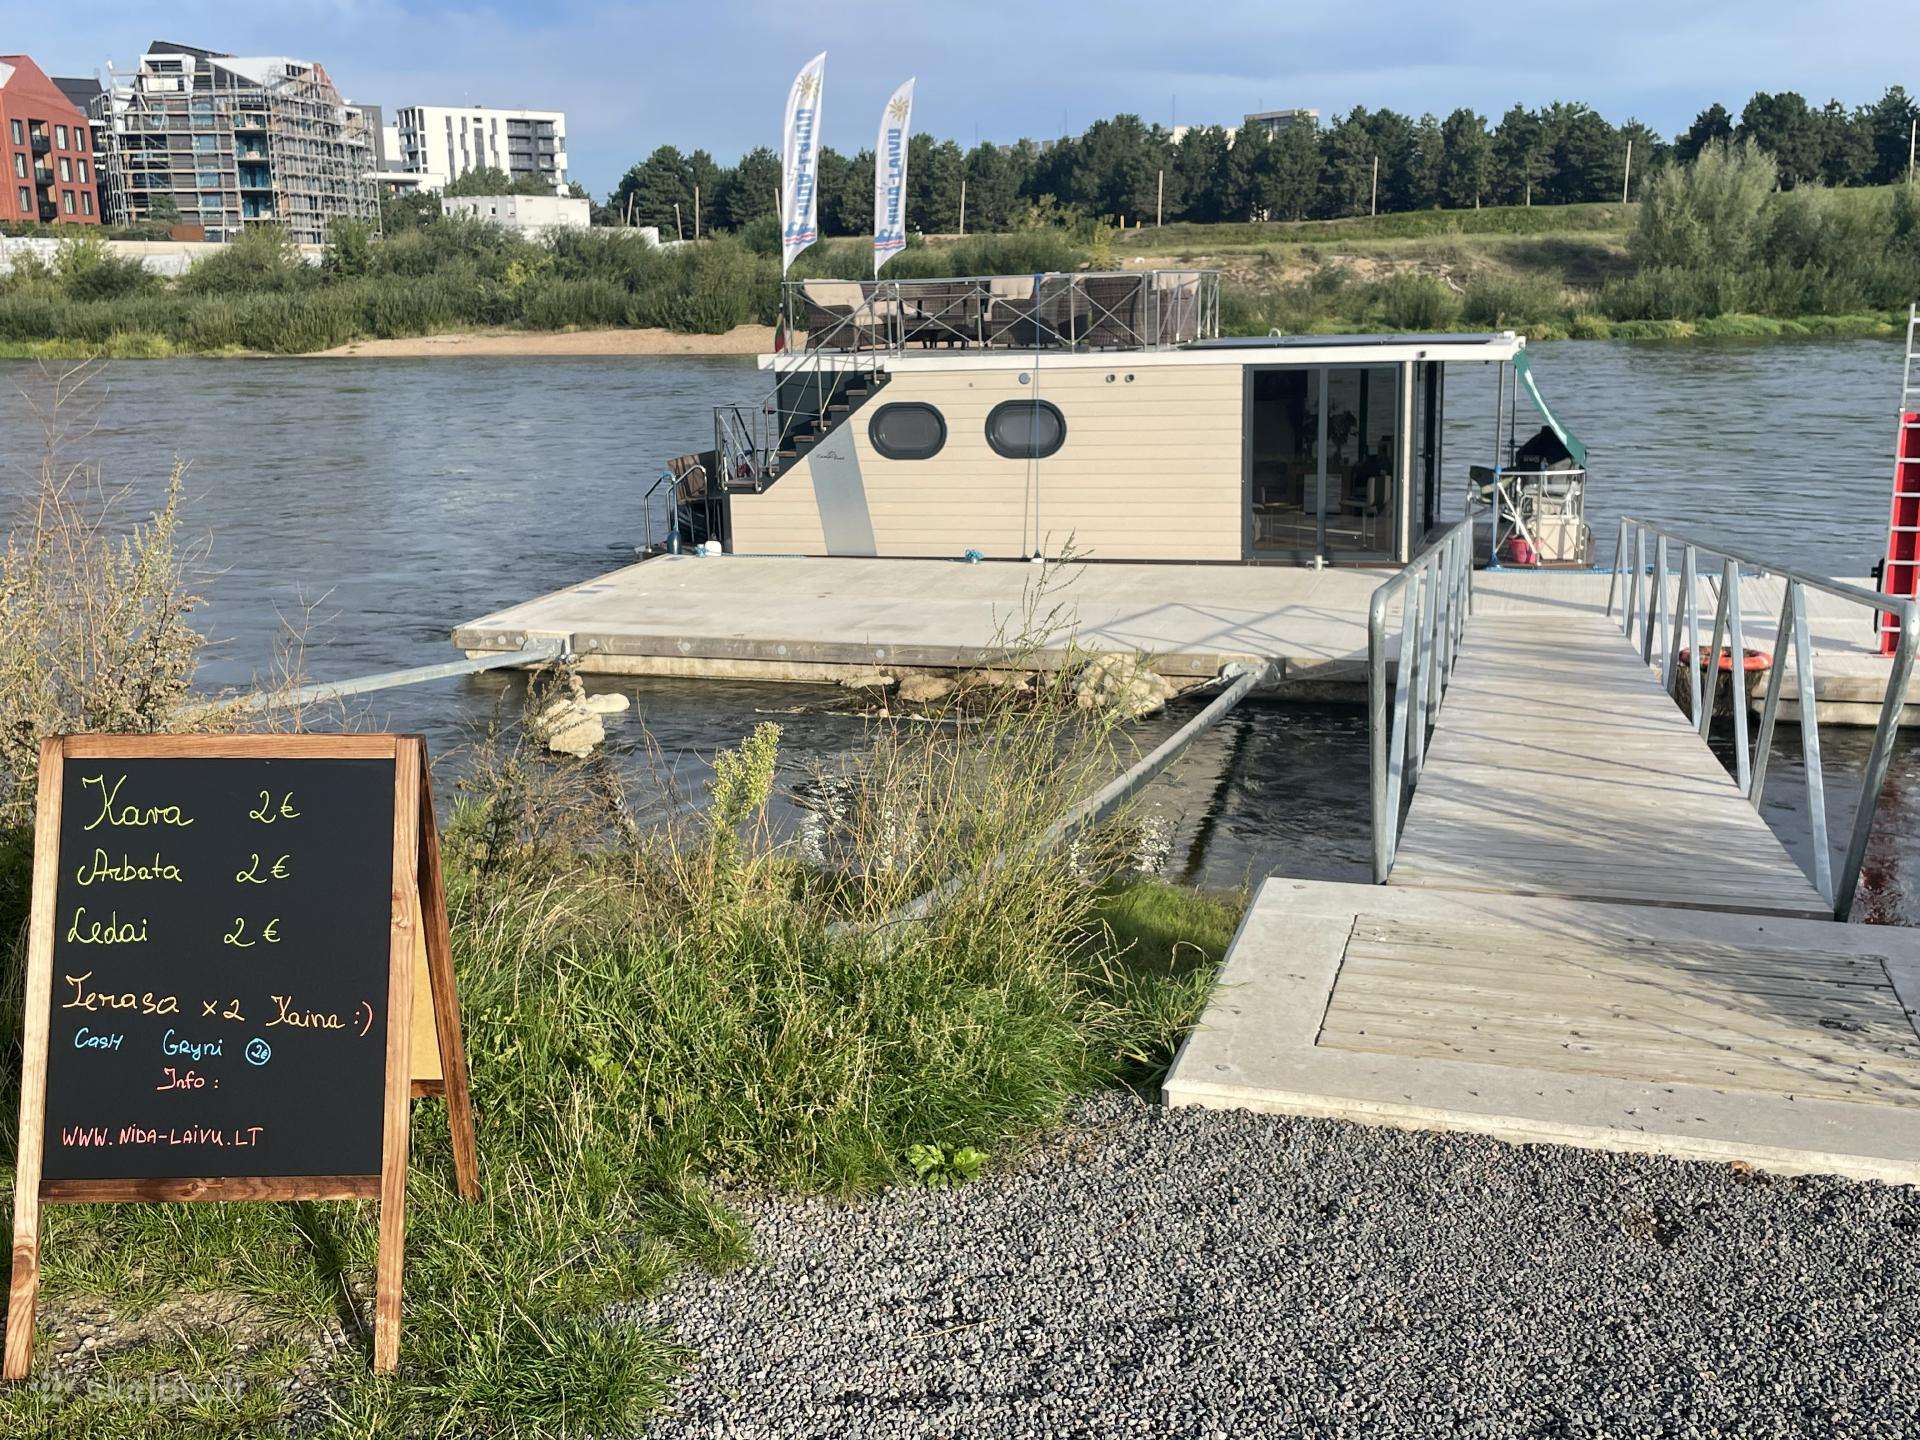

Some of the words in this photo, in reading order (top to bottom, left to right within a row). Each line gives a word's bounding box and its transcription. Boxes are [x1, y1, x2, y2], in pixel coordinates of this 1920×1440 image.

[82, 774, 194, 830] Kava
[77, 848, 183, 886] Arbata
[67, 907, 148, 945] Ledai
[62, 971, 180, 1014] Terasa
[265, 995, 346, 1029] Kaina
